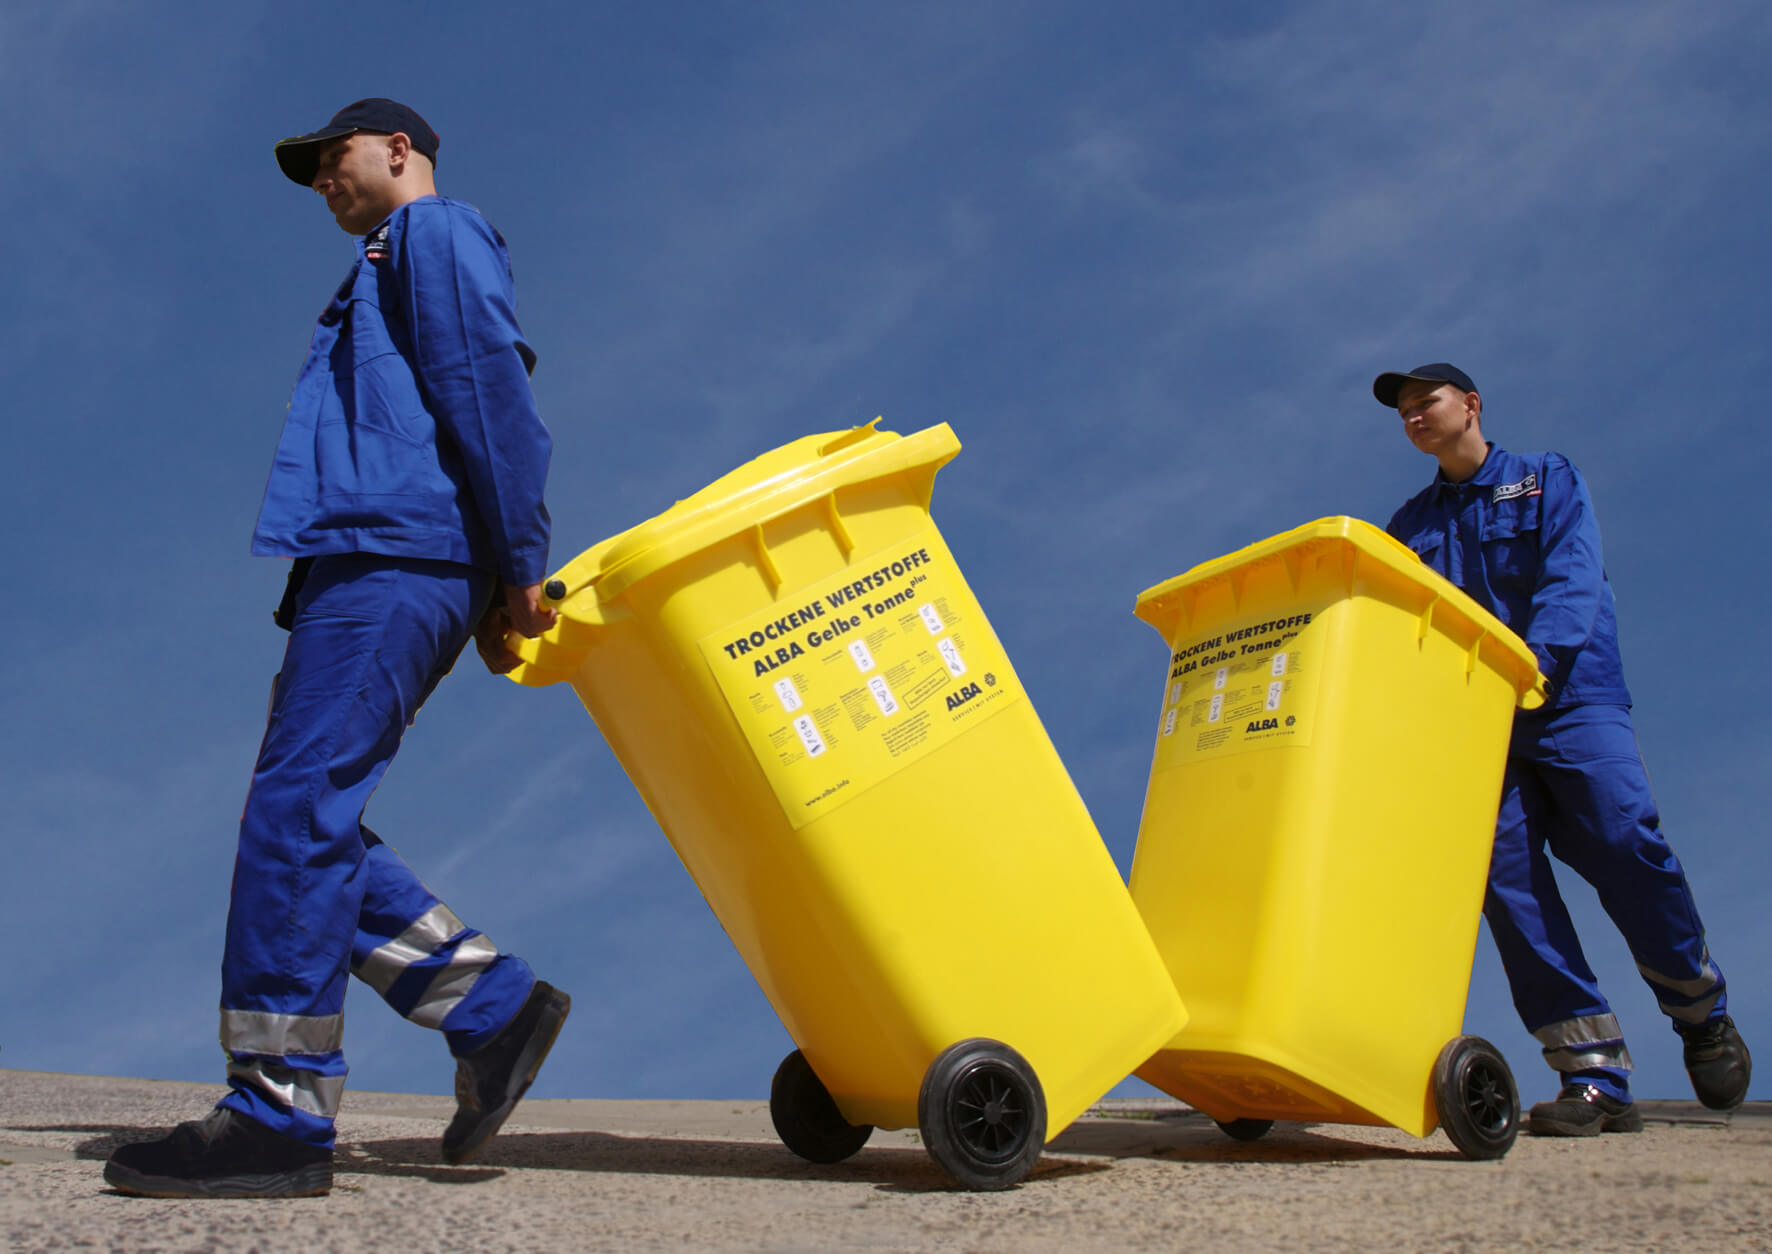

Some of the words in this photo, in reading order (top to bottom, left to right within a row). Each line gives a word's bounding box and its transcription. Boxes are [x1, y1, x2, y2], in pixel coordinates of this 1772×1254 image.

[724, 601, 825, 660] TROCKENE
[826, 548, 931, 608] WERTSTOFFE
[753, 648, 804, 677] ALBA
[807, 614, 861, 648] Gelbe
[1171, 637, 1223, 665] ROCKENE
[1226, 613, 1312, 644] WERTSTOFFE
[1170, 660, 1198, 680] ALBA
[1201, 649, 1236, 667] Gelbe
[945, 681, 983, 712] ALBA
[1246, 717, 1278, 734] ALBA
